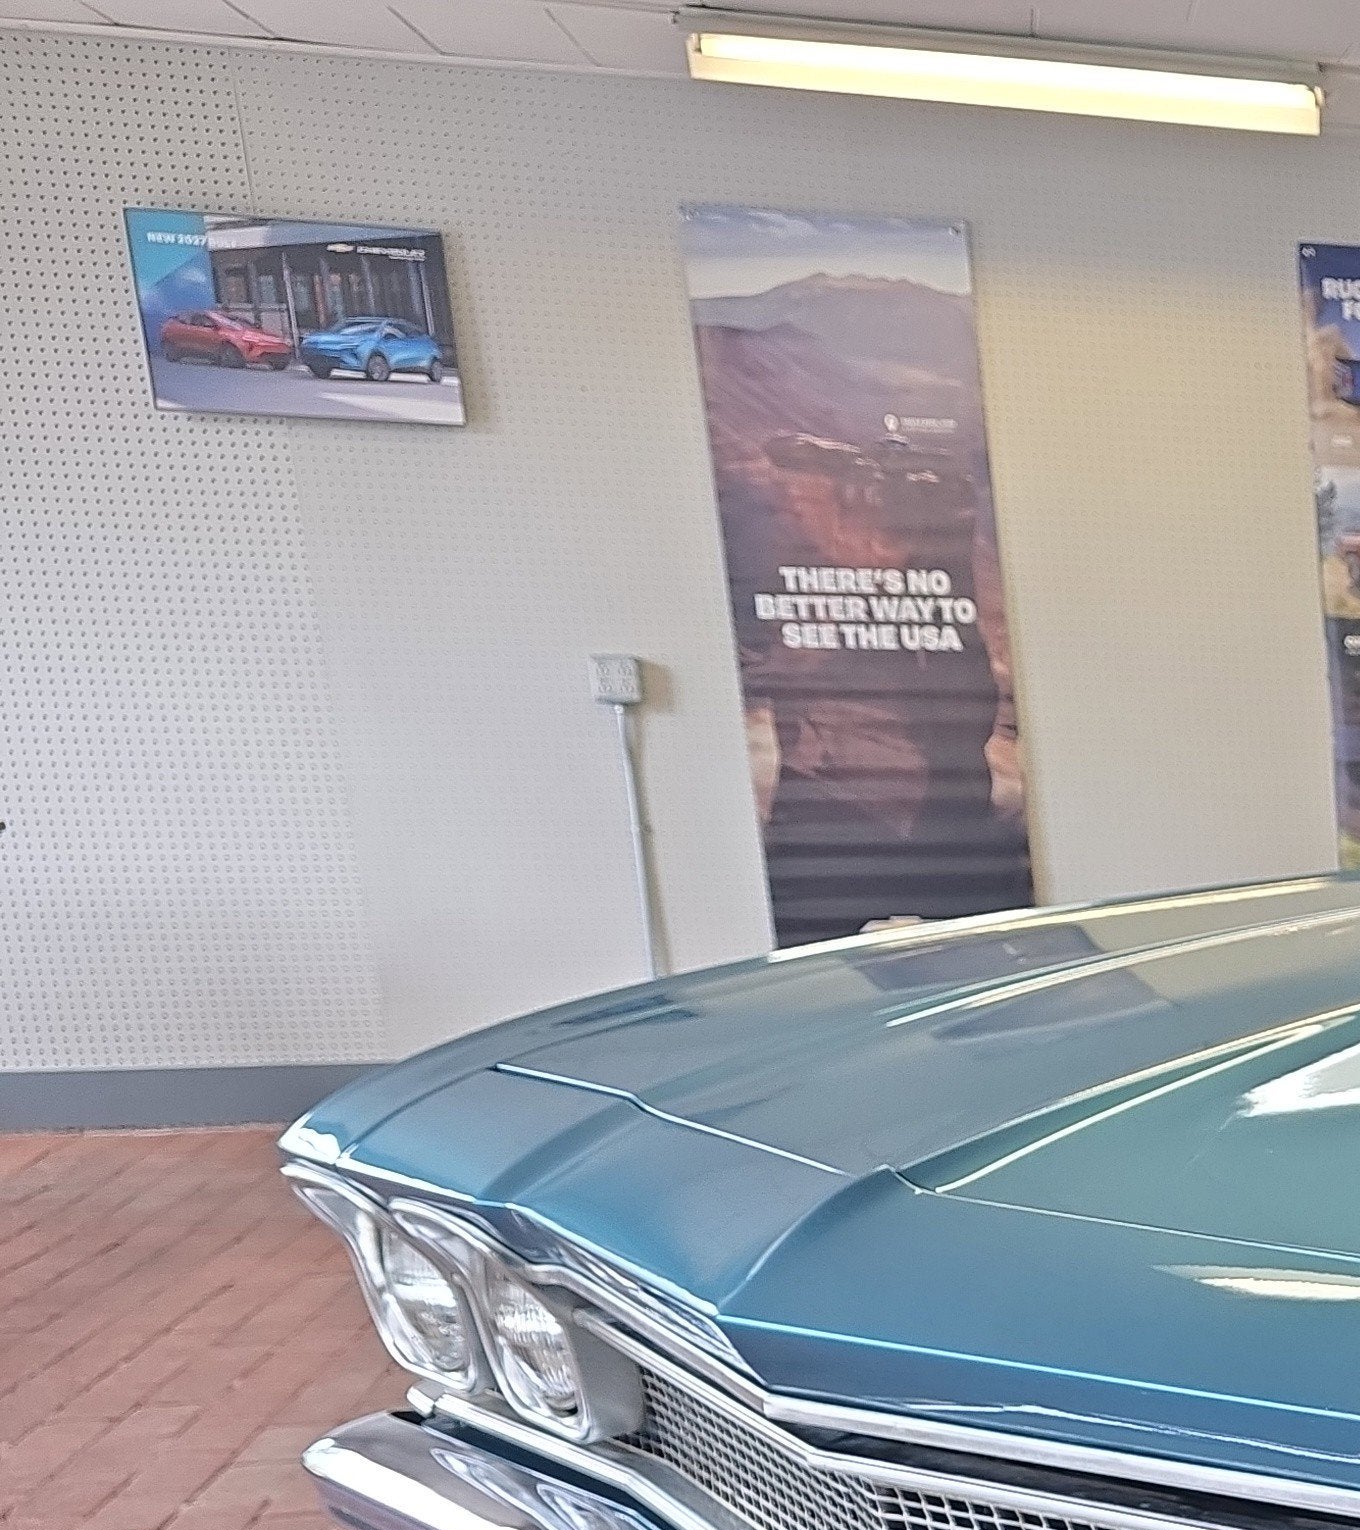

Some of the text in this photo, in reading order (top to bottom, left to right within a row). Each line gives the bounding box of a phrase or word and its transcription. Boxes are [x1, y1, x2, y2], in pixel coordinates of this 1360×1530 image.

[778, 566, 951, 595] THERE'S NO
[754, 594, 977, 624] BETTER WAY TO
[782, 624, 964, 651] SEE THE USA
